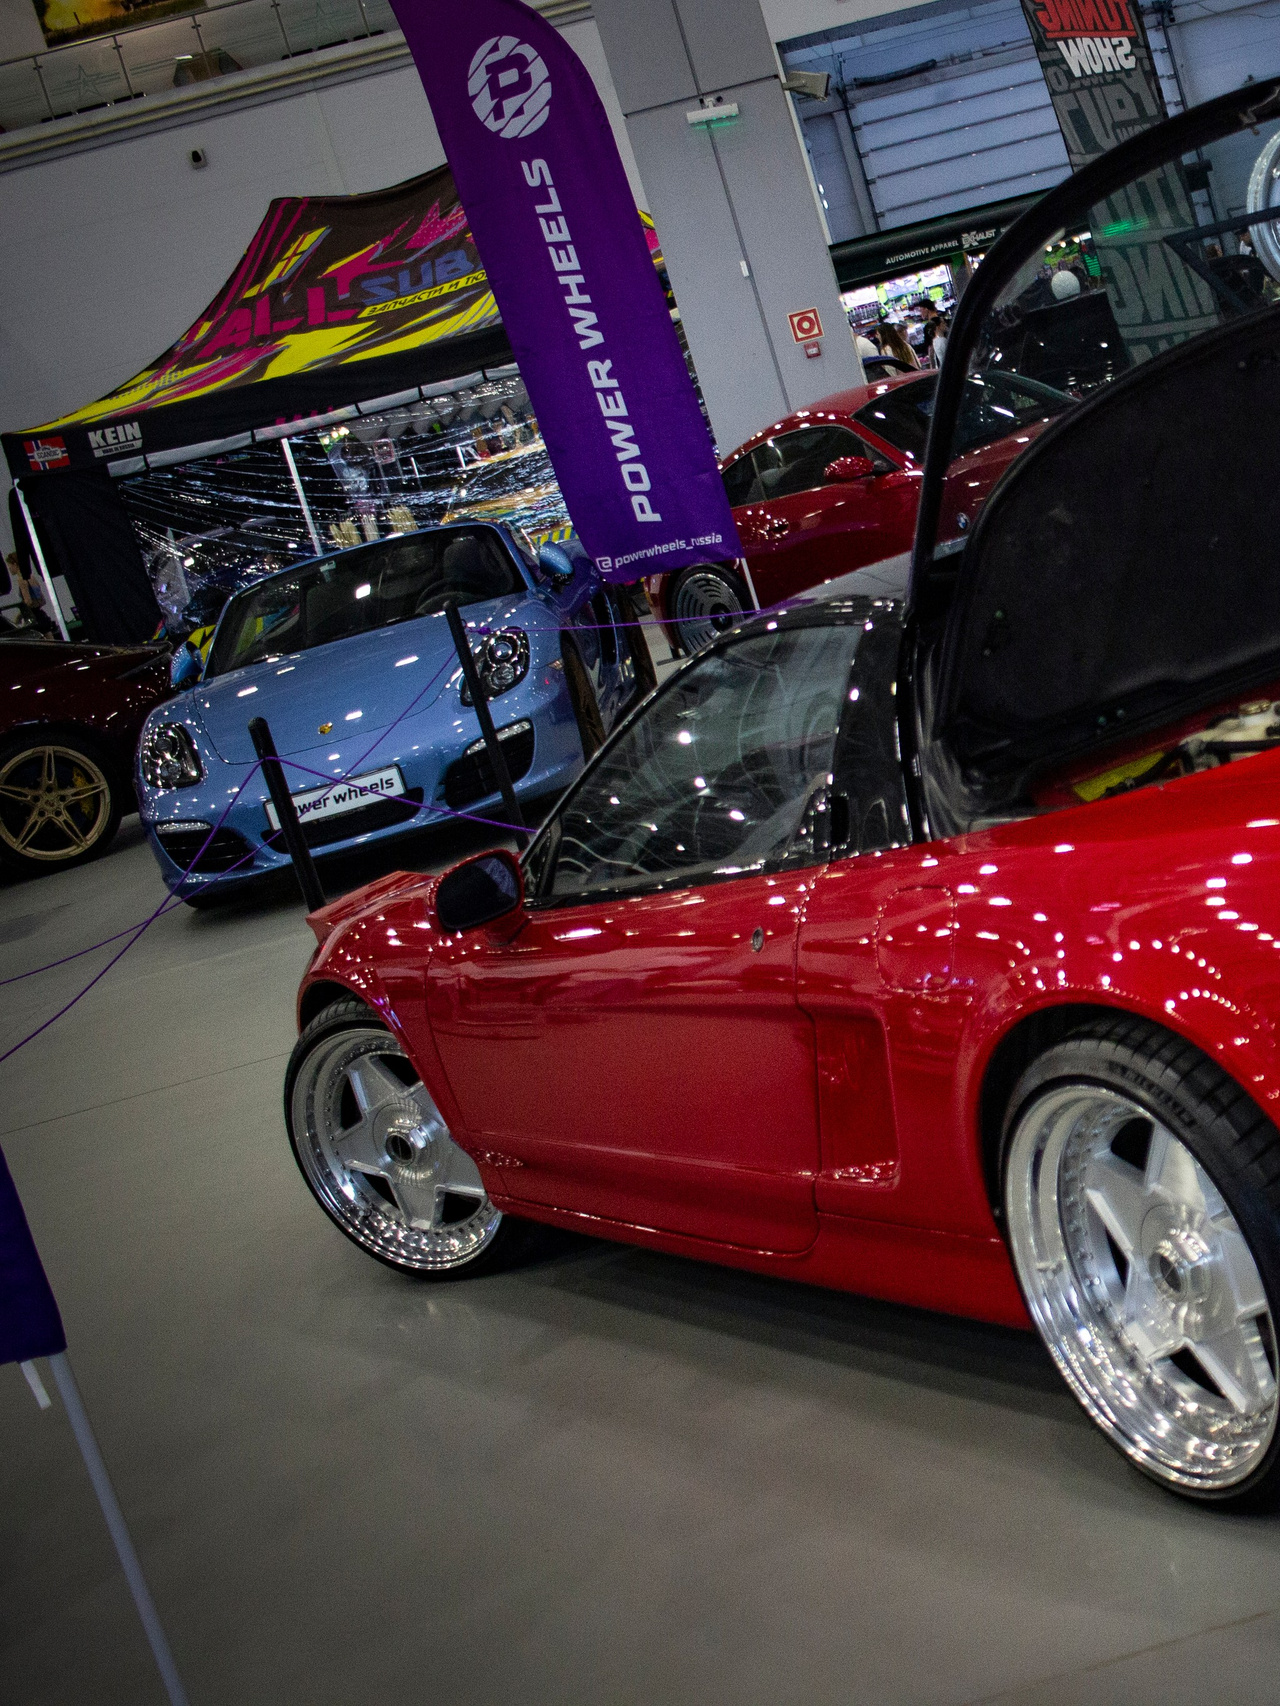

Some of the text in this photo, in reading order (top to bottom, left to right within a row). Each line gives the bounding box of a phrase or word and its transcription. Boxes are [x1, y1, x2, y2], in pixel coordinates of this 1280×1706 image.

[885, 247, 929, 265] AUTOMOTIVE
[930, 239, 959, 253] APPAREL
[361, 249, 485, 305] SUB
[368, 271, 489, 315] ЗАПЧАСТИ И ТЮ
[522, 157, 662, 524] POWER WHEELS
[88, 421, 142, 449] KEIN
[333, 777, 395, 805] wheels
